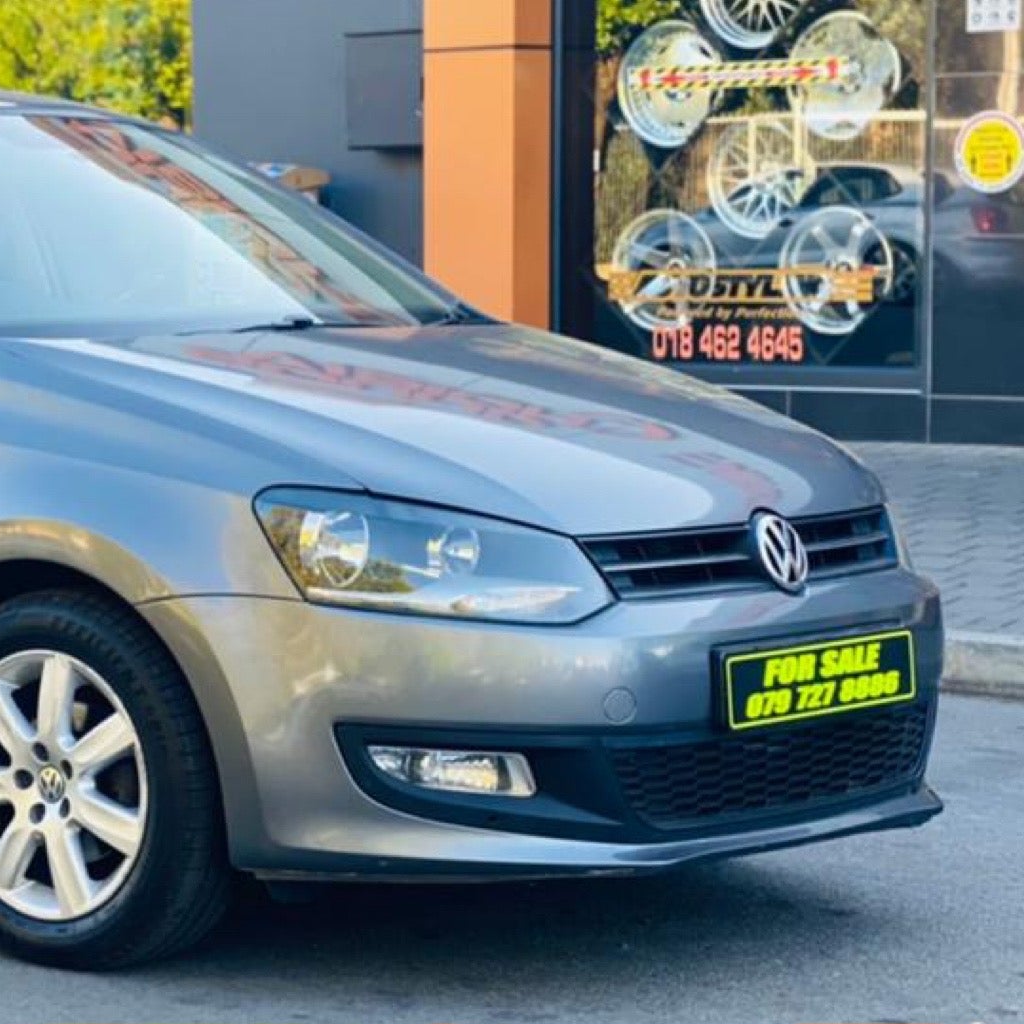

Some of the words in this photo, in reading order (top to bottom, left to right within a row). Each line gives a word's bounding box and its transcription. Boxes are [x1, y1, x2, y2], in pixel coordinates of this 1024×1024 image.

[652, 325, 694, 360] 018
[698, 325, 741, 360] 462
[747, 325, 804, 361] 4645
[764, 653, 816, 687] FOR
[820, 642, 881, 678] SALE
[796, 681, 837, 711] 727
